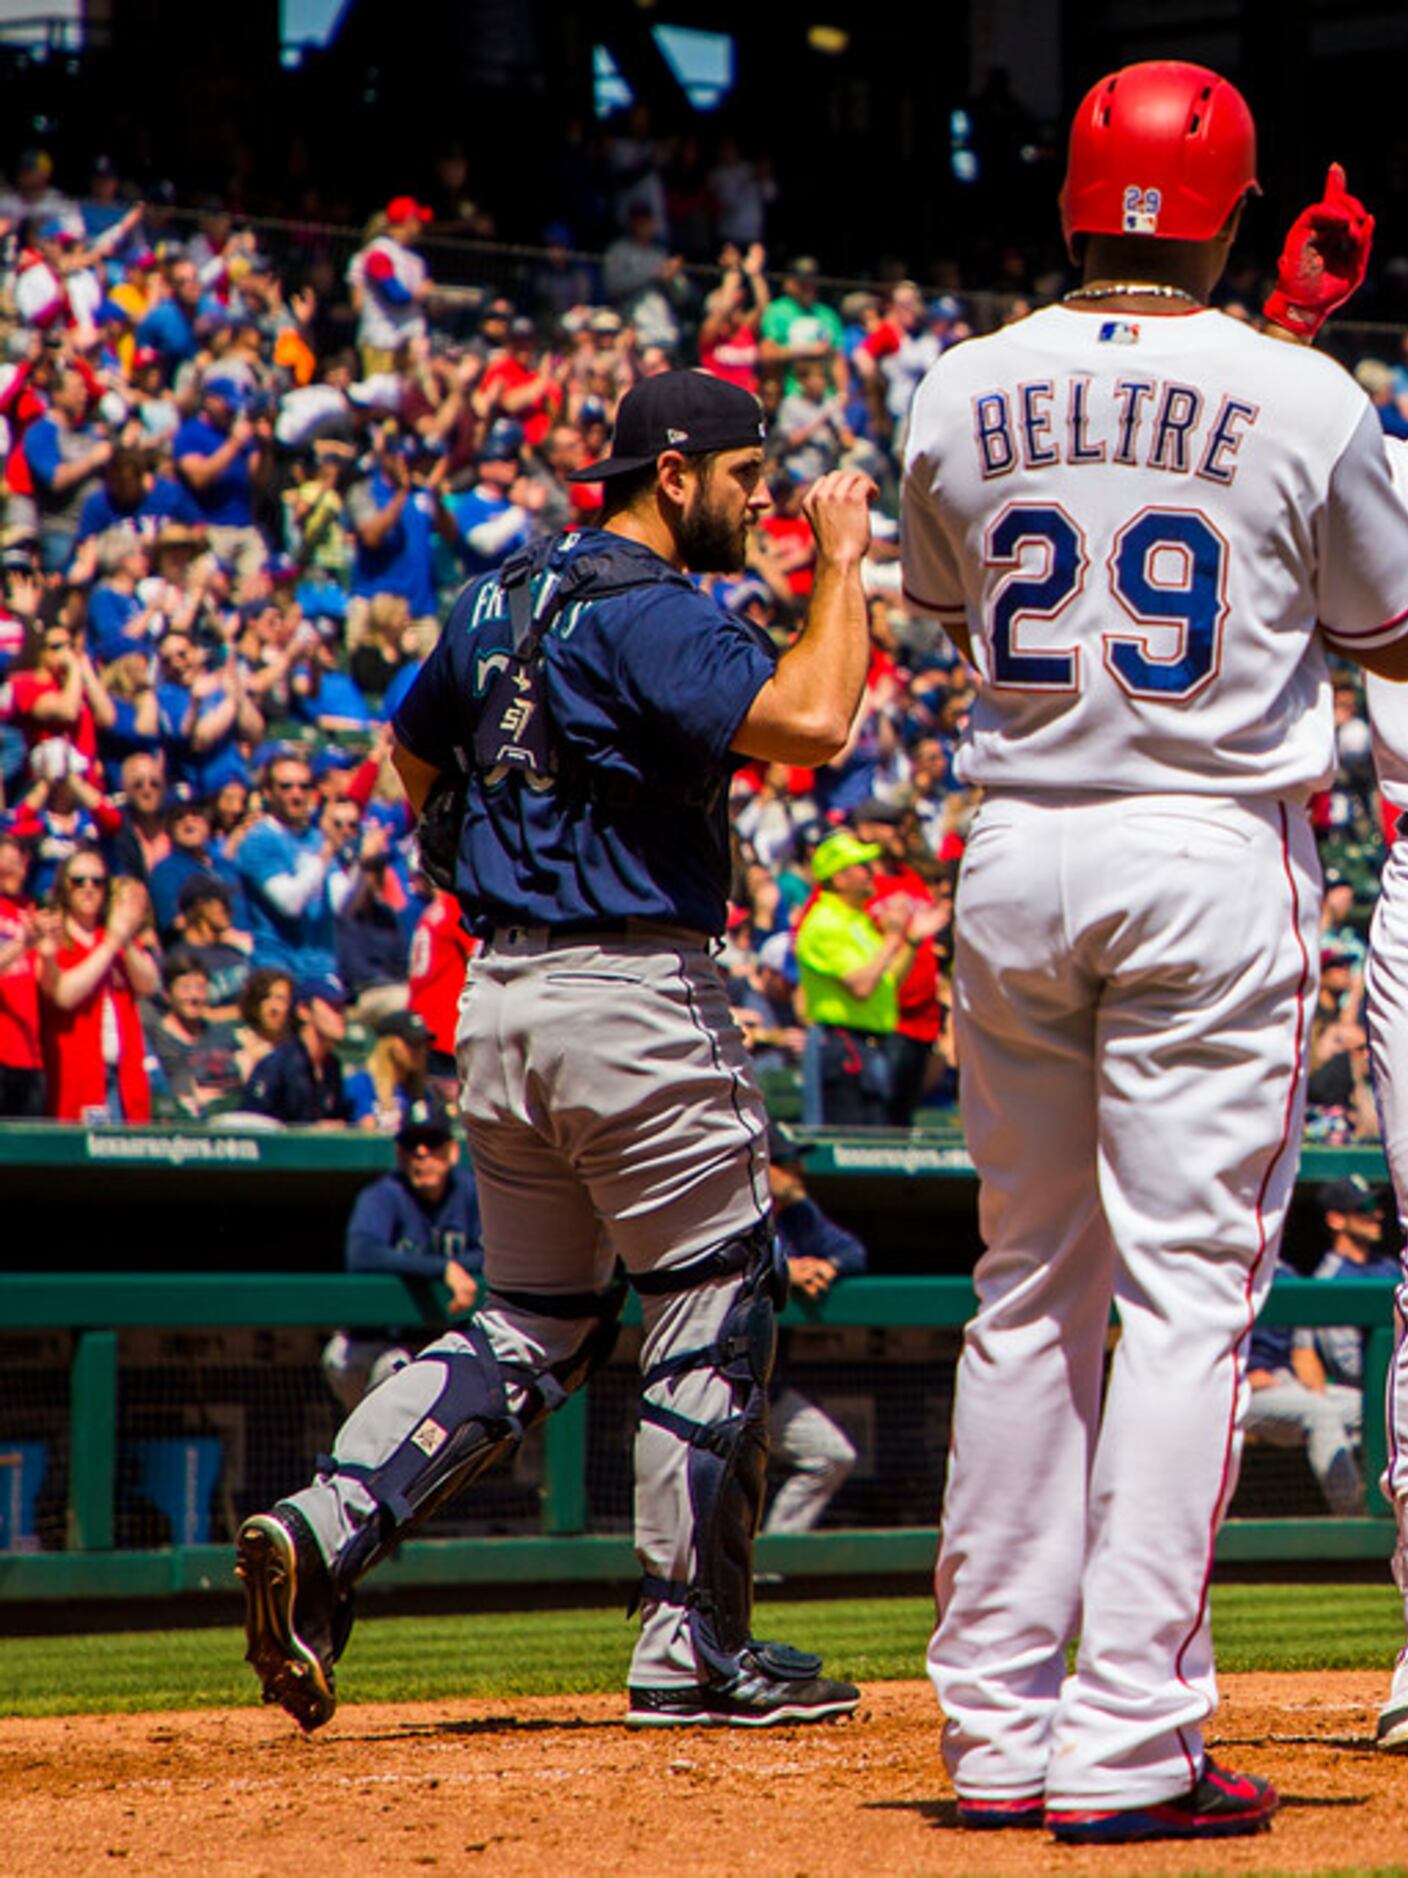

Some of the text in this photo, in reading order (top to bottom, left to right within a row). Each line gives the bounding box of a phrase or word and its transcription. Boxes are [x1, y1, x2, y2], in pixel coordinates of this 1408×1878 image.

[1124, 184, 1162, 215] 29
[971, 377, 1259, 488] BELTRE
[983, 500, 1231, 703] 29
